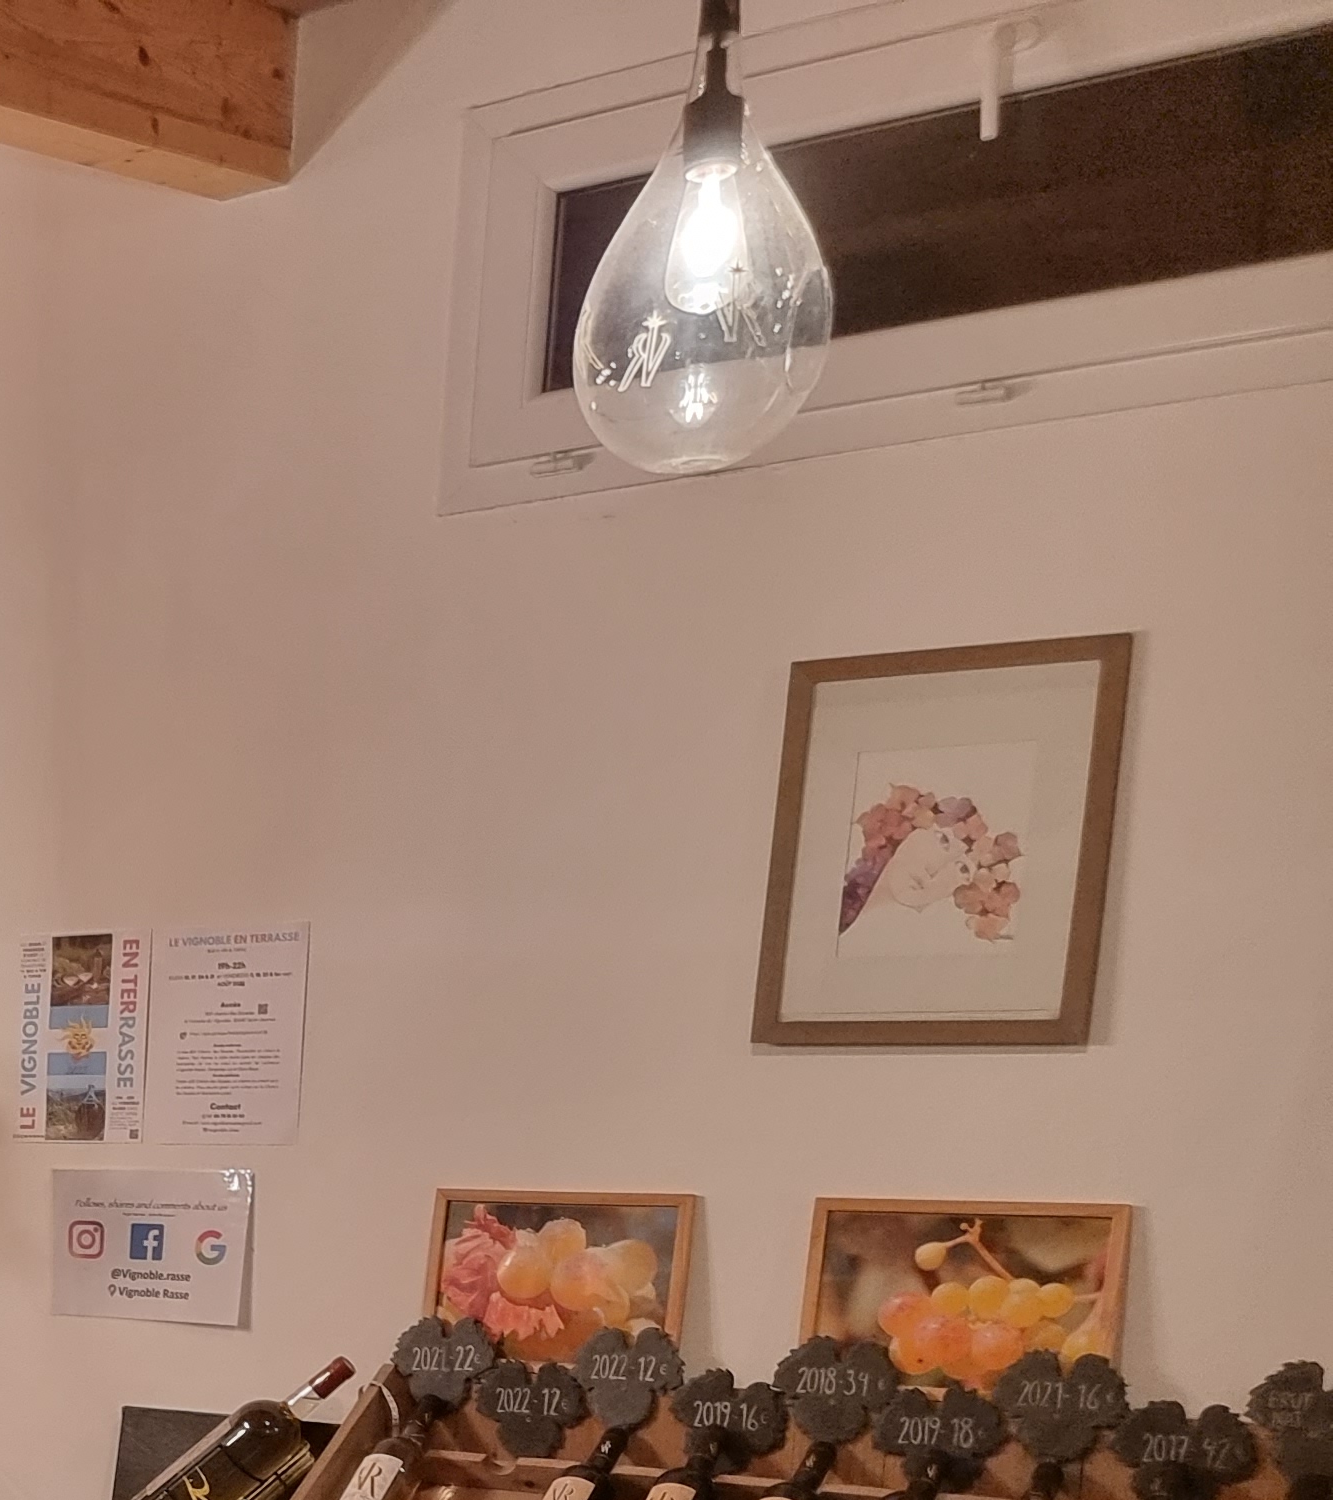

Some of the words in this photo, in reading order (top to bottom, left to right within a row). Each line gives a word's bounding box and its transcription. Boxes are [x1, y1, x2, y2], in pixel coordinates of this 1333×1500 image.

[121, 939, 140, 969] EN
[169, 938, 179, 947] LE
[182, 935, 231, 947] VIGNOBLE
[234, 934, 247, 944] EN
[250, 932, 299, 943] TERRASSE
[20, 982, 41, 1096] VIGNOBLE
[116, 974, 138, 1088] TERRASSE
[19, 1107, 36, 1129] LE
[110, 1268, 191, 1282] @Vignoble.rasse
[118, 1286, 160, 1298] Vignoble
[162, 1289, 190, 1300] Rasse
[453, 1344, 475, 1371] 22
[590, 1353, 627, 1380] 2022
[638, 1356, 656, 1382] 12
[796, 1367, 836, 1395] 2018
[496, 1387, 531, 1413] 2022
[541, 1387, 561, 1416] 12
[693, 1401, 731, 1427] 2019
[739, 1403, 759, 1431] 16
[897, 1417, 941, 1445] 2019
[950, 1417, 974, 1448] 18
